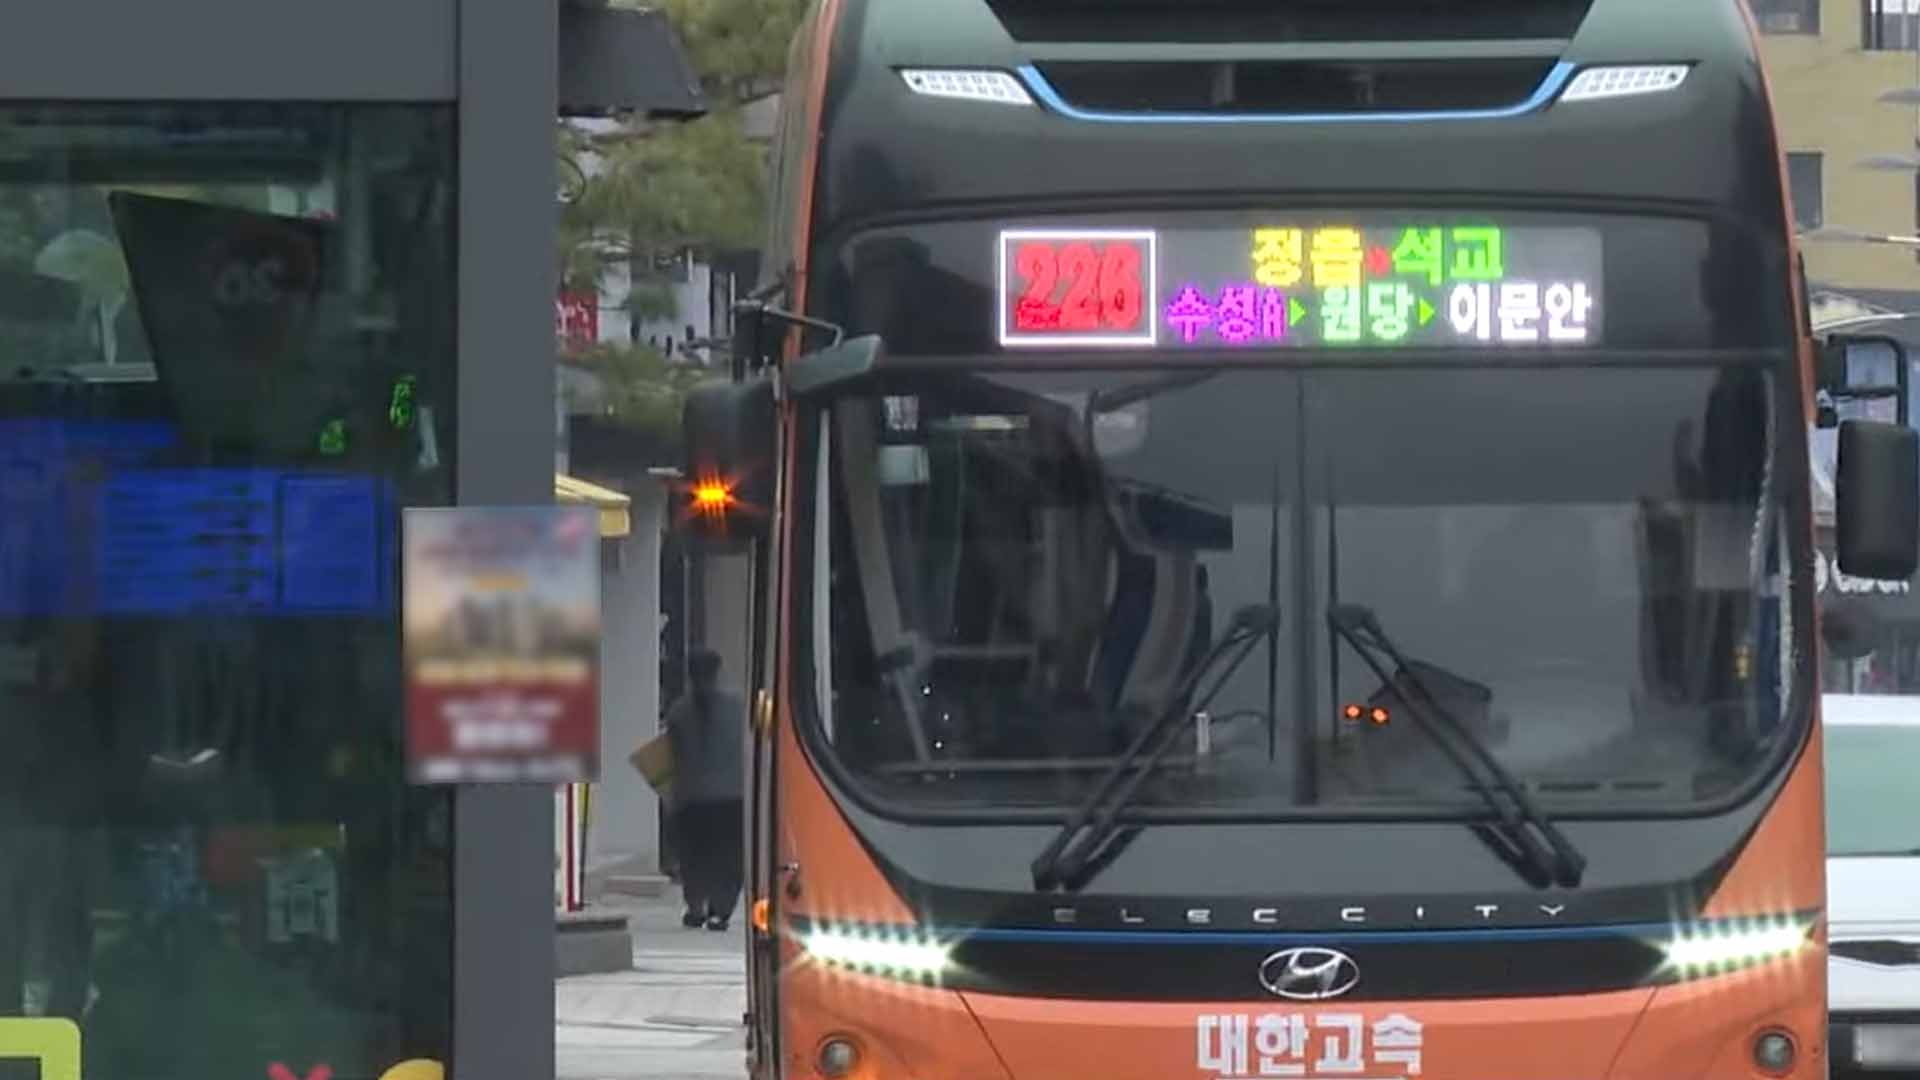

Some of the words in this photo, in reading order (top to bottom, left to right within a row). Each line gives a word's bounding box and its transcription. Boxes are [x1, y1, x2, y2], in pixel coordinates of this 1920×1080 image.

[1392, 227, 1503, 287] 석교
[1321, 283, 1414, 341] 원당
[1450, 283, 1592, 339] 이문안
[1053, 908, 1278, 923] ELEC
[1340, 904, 1565, 921] CITY
[1196, 1013, 1423, 1076] 대한고속
